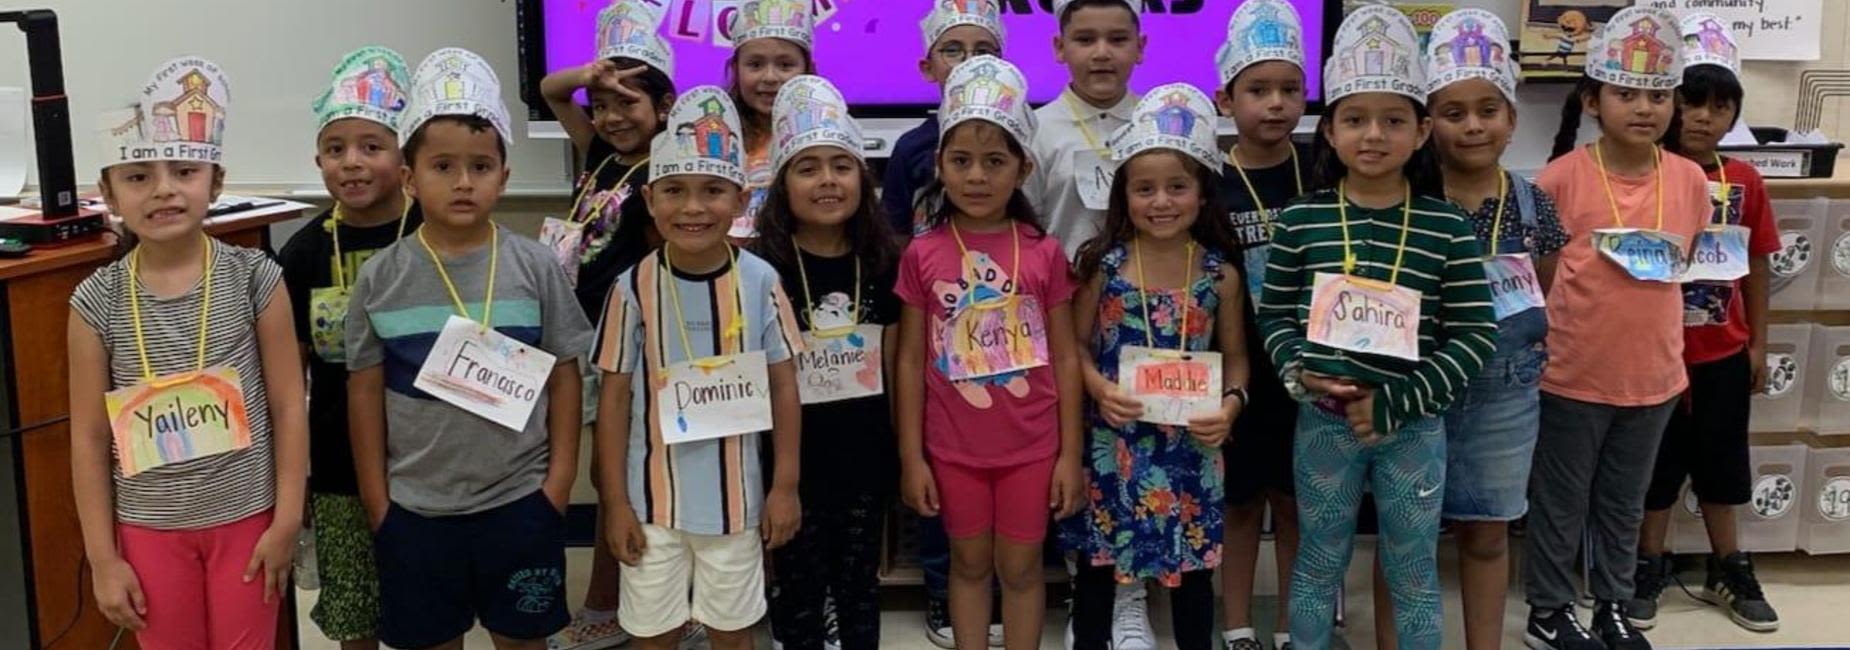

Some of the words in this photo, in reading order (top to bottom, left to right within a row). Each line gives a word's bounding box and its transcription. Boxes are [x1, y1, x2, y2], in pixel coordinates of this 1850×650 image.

[1354, 79, 1387, 90] First
[1618, 73, 1649, 86] First
[119, 146, 128, 160] I
[131, 148, 159, 160] am
[163, 147, 174, 159] a
[178, 144, 208, 159] First
[1158, 135, 1187, 147] First
[662, 162, 680, 173] am
[684, 162, 694, 172] a
[697, 160, 727, 174] First
[1332, 289, 1406, 329] Sahira
[965, 318, 1032, 353] Kenya
[797, 348, 865, 372] Melanie
[1142, 366, 1210, 393] Maddie
[673, 374, 756, 412] Dominic
[133, 394, 230, 440] Yaileny
